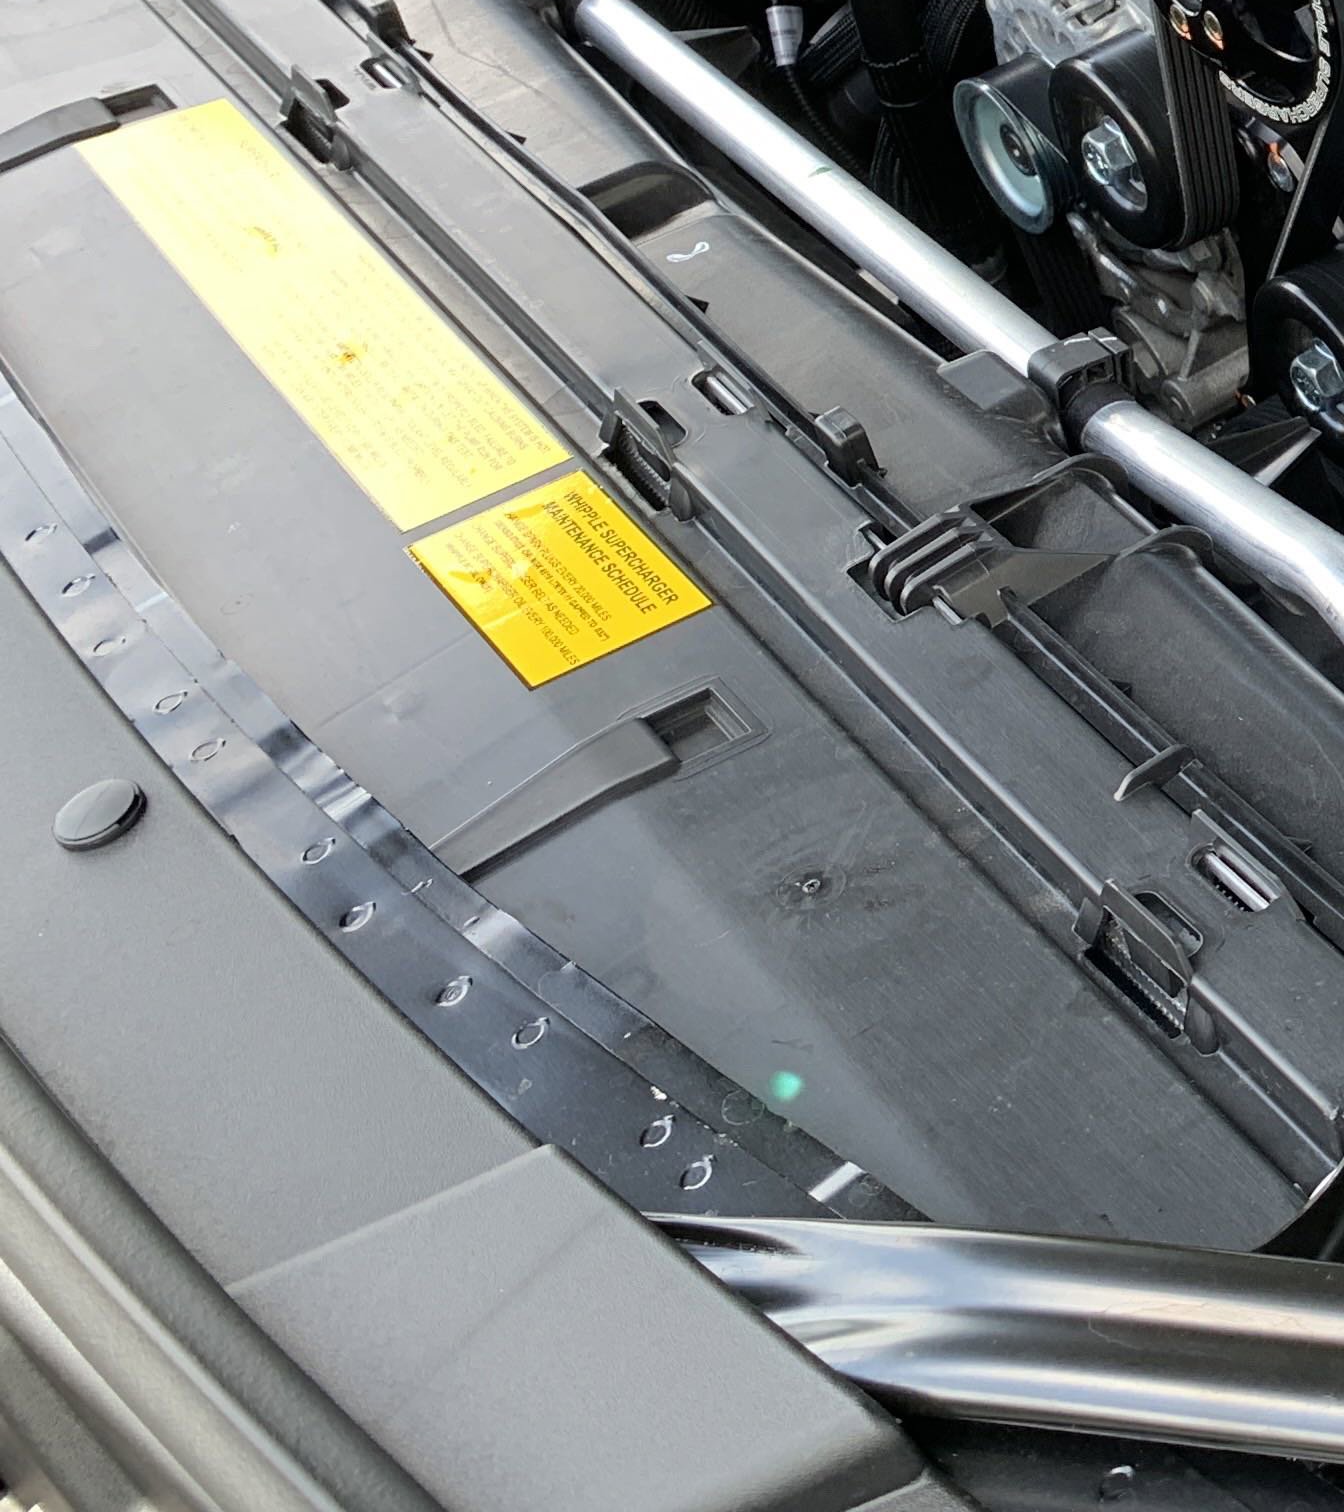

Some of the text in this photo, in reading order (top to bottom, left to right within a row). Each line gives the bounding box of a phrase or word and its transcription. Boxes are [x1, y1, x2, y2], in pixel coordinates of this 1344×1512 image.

[540, 500, 610, 565] MAINTENANCE
[600, 561, 658, 615] SCHEDULE
[561, 490, 681, 606] WHIPPLE SUPERCHARGER
[550, 608, 580, 636] NEEDED
[588, 601, 613, 622] MILES
